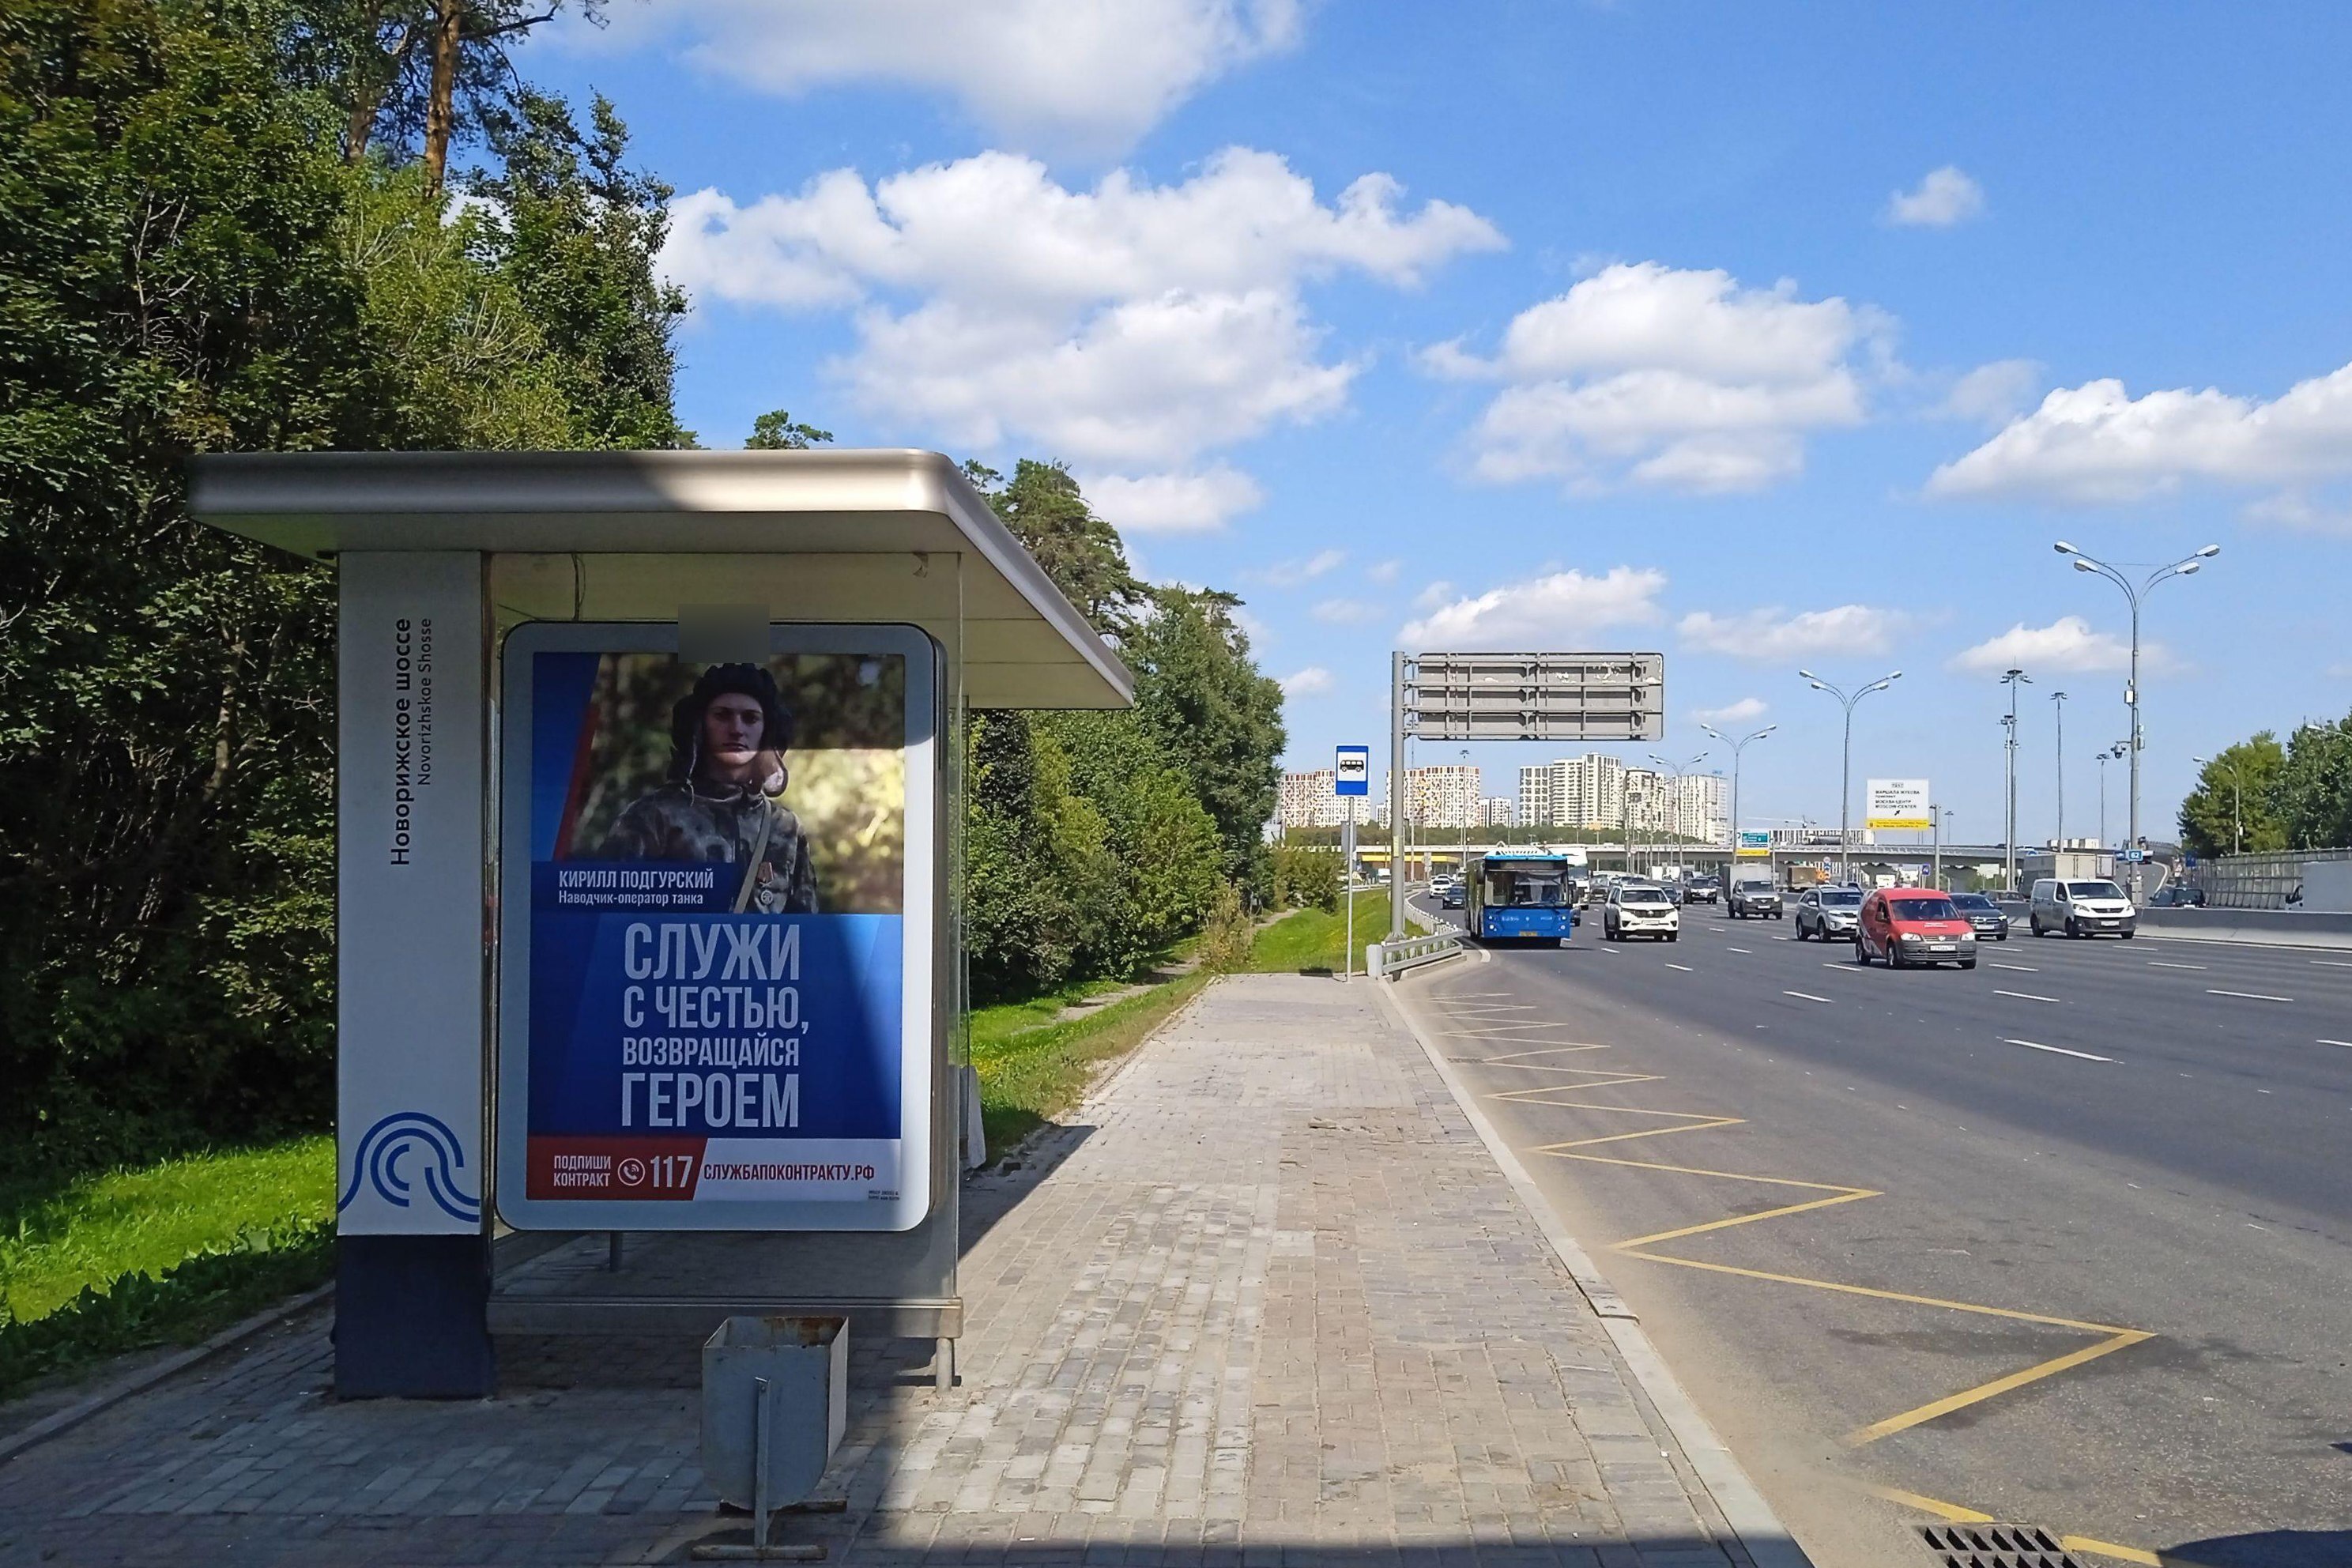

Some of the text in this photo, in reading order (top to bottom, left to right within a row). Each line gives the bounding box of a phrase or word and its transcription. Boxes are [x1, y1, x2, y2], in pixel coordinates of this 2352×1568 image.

[417, 618, 432, 786] Novorizhskoe Shosse
[390, 618, 415, 865] Новорижское шоссе
[558, 868, 714, 890] КИРИЛЛ ПОДГУРСКИЙ
[558, 890, 704, 906] Наводчик-оператор танка
[624, 922, 800, 981] СЛУЖИ
[623, 985, 809, 1035] С ЧЕСТЬЮ,
[622, 1031, 800, 1069] ВОЗВРАЩАЙСЯ
[621, 1072, 800, 1129] ГЕРОЕМ
[552, 1172, 611, 1187] КОНТРАКТ
[553, 1155, 612, 1171] ПОДПИШИ
[649, 1155, 694, 1189] 117
[703, 1163, 875, 1182] СЛУЖБАПОКОНТРАКТУ.РФ
